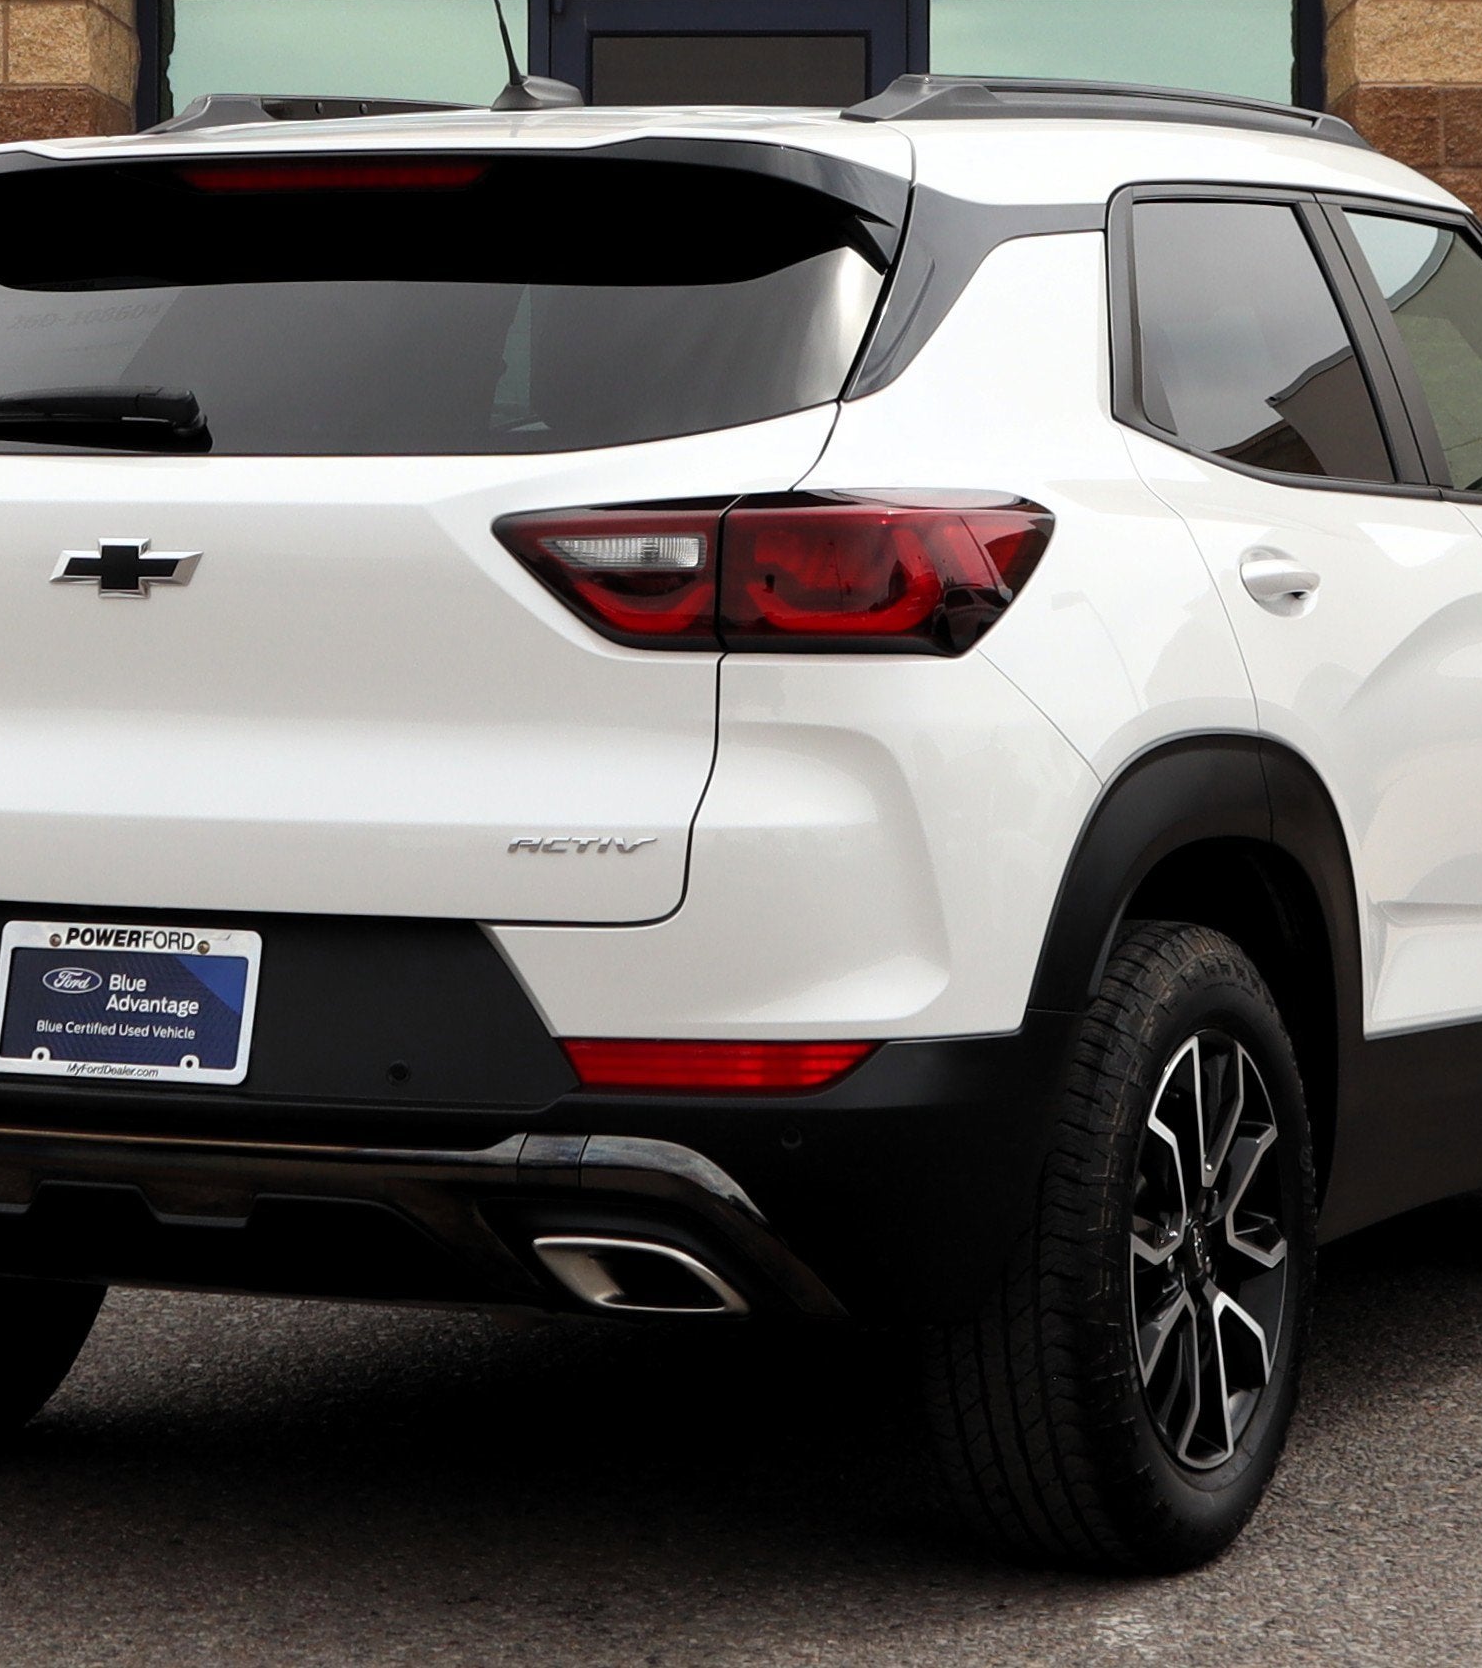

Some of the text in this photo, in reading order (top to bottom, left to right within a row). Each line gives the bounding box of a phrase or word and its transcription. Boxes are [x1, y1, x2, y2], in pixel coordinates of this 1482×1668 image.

[506, 836, 659, 854] ACTIV
[65, 927, 195, 950] POWERFORD
[53, 970, 91, 990] Ford
[109, 974, 147, 992] Blue
[105, 994, 200, 1018] Advantage
[36, 1019, 196, 1040] Blue Certified Used Vehicle
[67, 1062, 159, 1078] MyFordDealer.com
